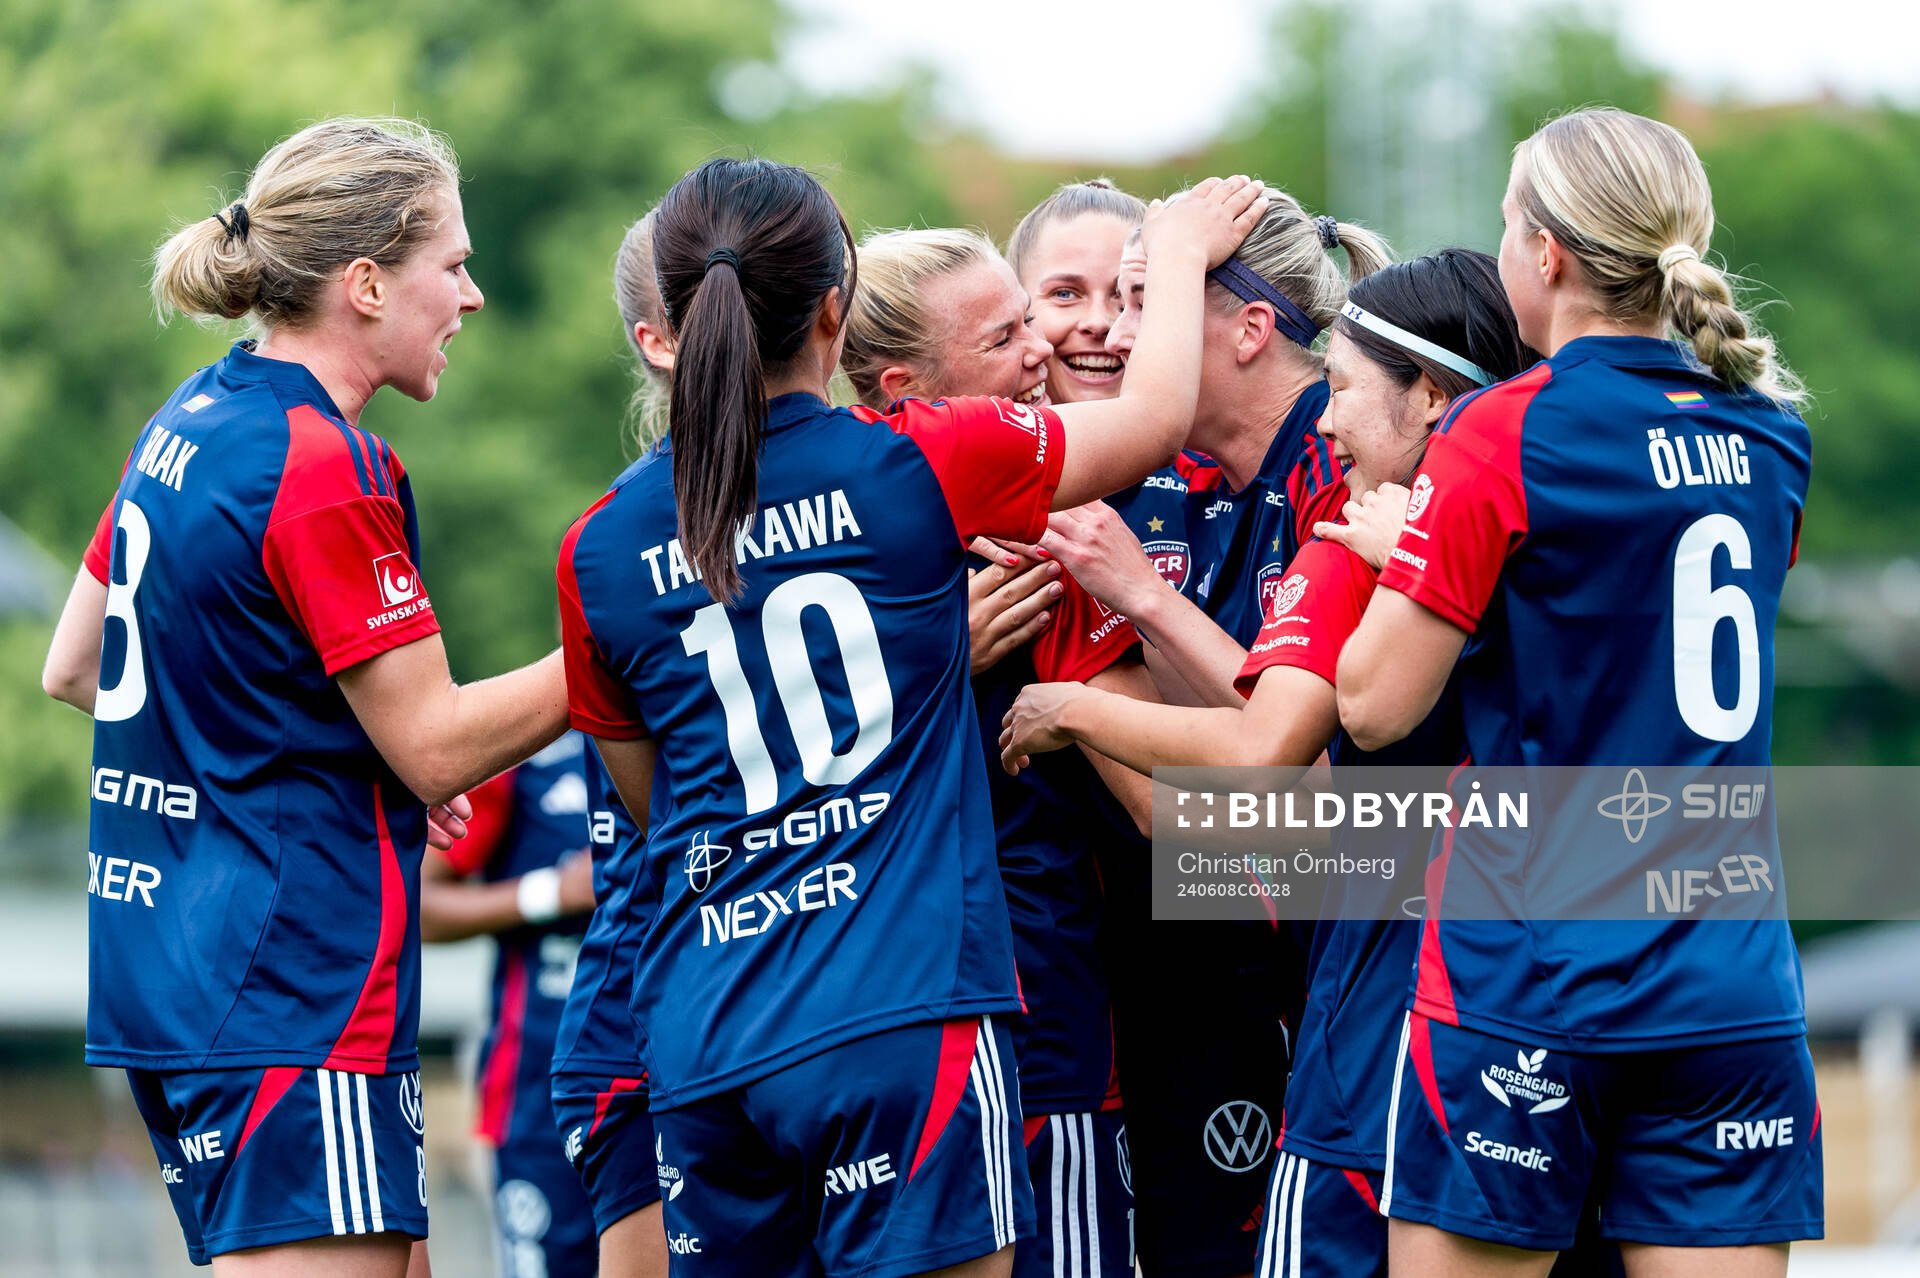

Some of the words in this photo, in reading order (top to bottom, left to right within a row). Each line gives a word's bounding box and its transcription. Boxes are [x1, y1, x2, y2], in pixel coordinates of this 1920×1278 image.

[1648, 427, 1751, 489] ÖLING
[640, 489, 862, 596] TAKAWA
[1149, 555, 1183, 574] CR
[94, 499, 151, 722] 8
[1263, 581, 1281, 599] FC
[366, 603, 418, 630] SVENSKA
[1090, 613, 1128, 643] SVENS
[1673, 513, 1760, 743] 6
[679, 572, 894, 815] 10
[1489, 1064, 1566, 1097] ROSENGÅRD
[1504, 1083, 1544, 1102] CENTRUM
[1464, 1131, 1552, 1173] Scandic
[1716, 1116, 1794, 1150] RWE
[416, 1145, 427, 1208] 8
[824, 1152, 897, 1197] RWE
